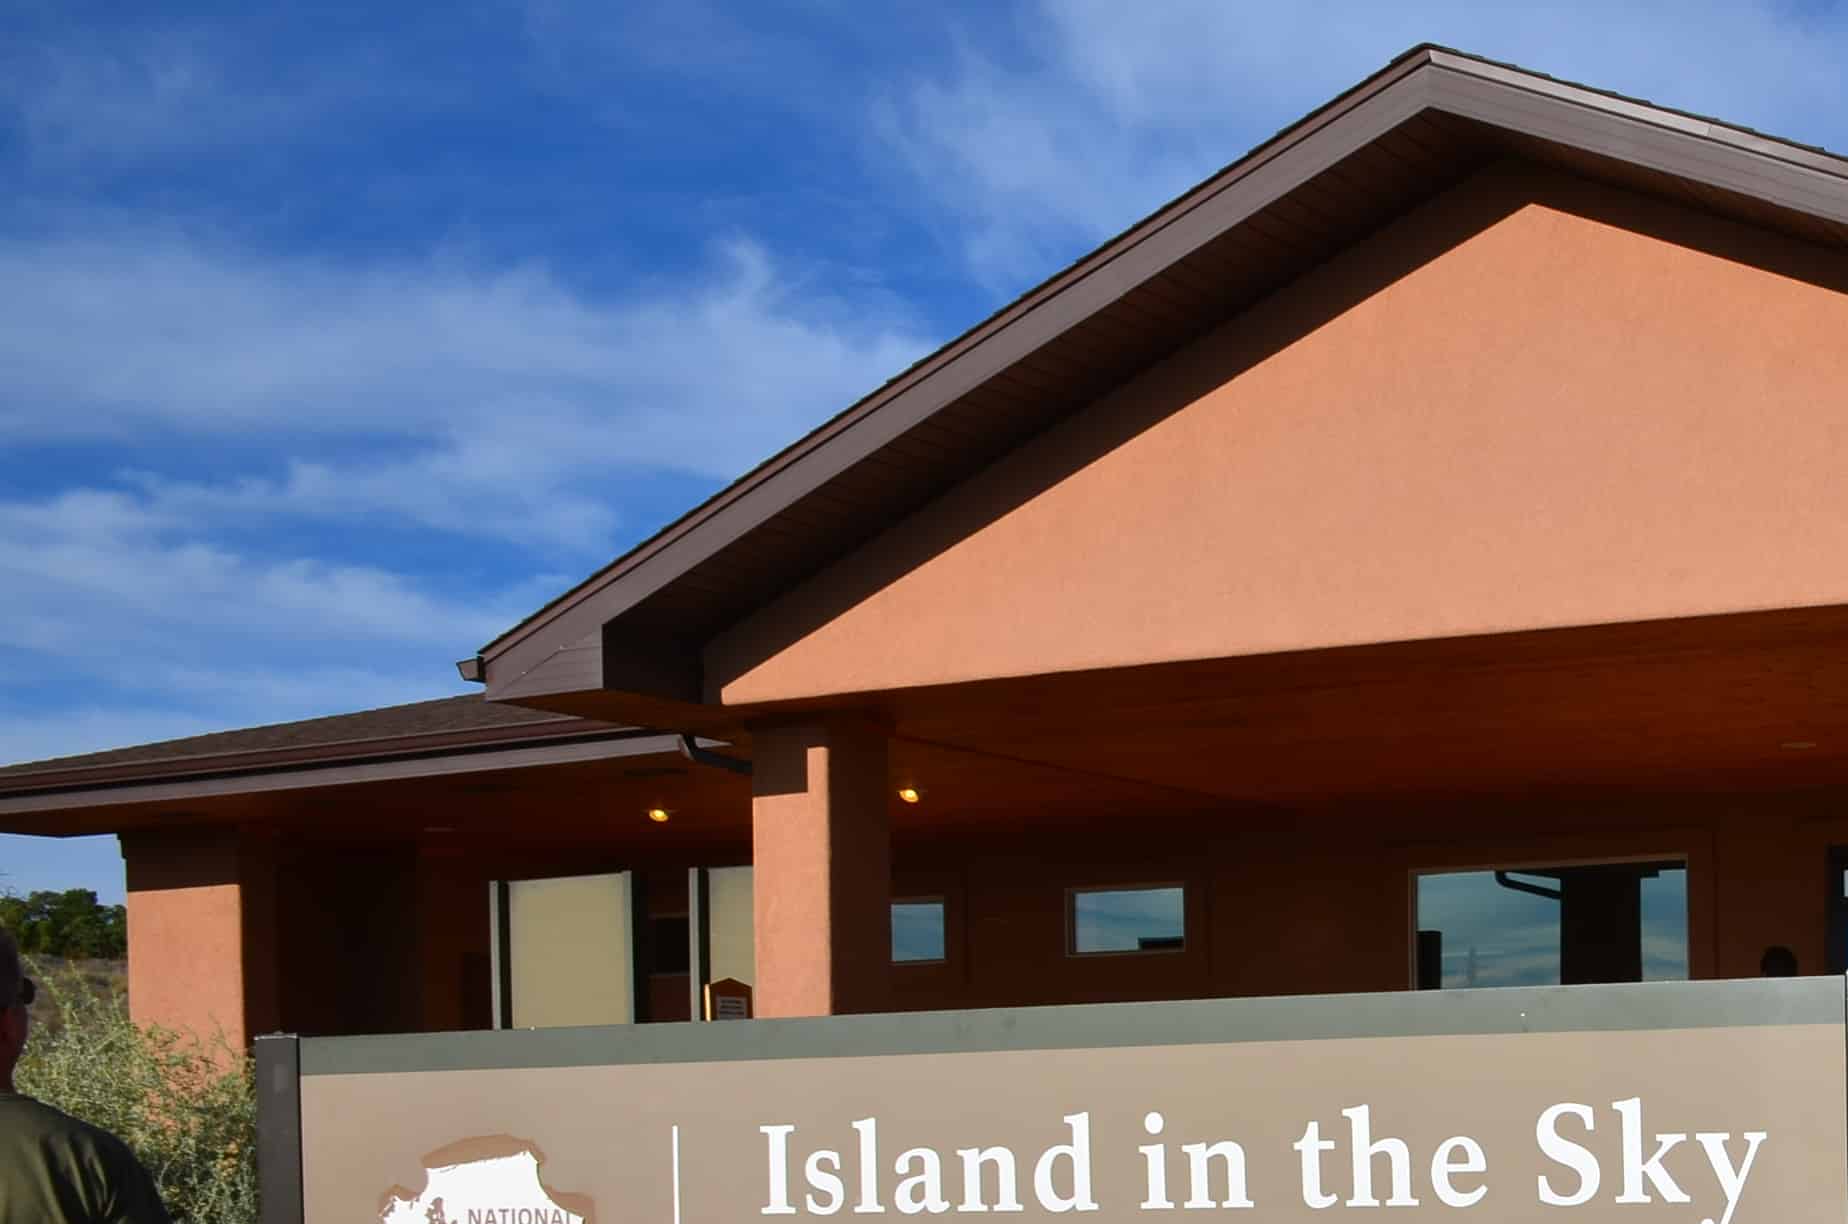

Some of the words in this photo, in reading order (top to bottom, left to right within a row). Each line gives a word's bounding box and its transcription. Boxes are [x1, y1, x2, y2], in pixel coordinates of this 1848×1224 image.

[759, 1111, 1099, 1216] Island
[1138, 1111, 1255, 1210] in
[1293, 1103, 1488, 1209] the
